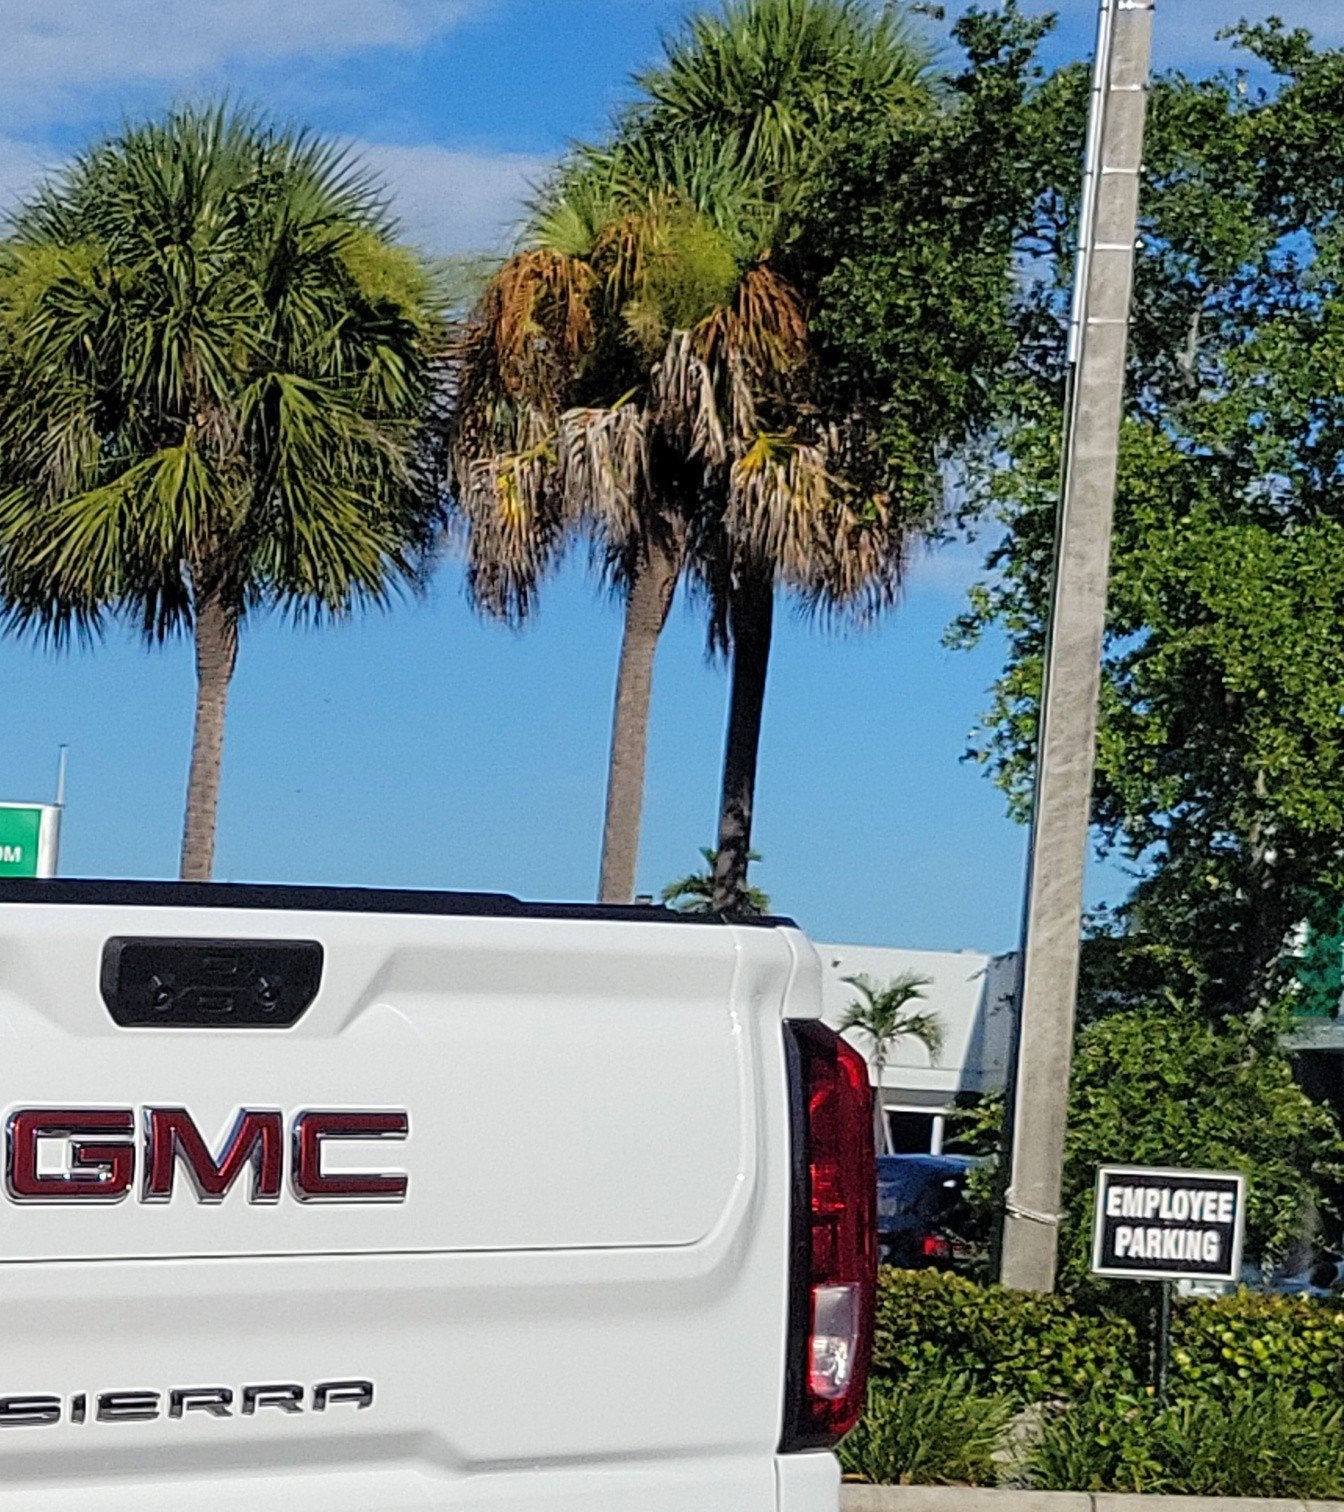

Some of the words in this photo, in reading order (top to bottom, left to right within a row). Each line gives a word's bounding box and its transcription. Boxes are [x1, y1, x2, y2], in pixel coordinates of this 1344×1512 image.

[5, 1105, 409, 1204] GMC
[1106, 1185, 1234, 1223] EMPLOYEE
[1114, 1225, 1221, 1263] PARKING
